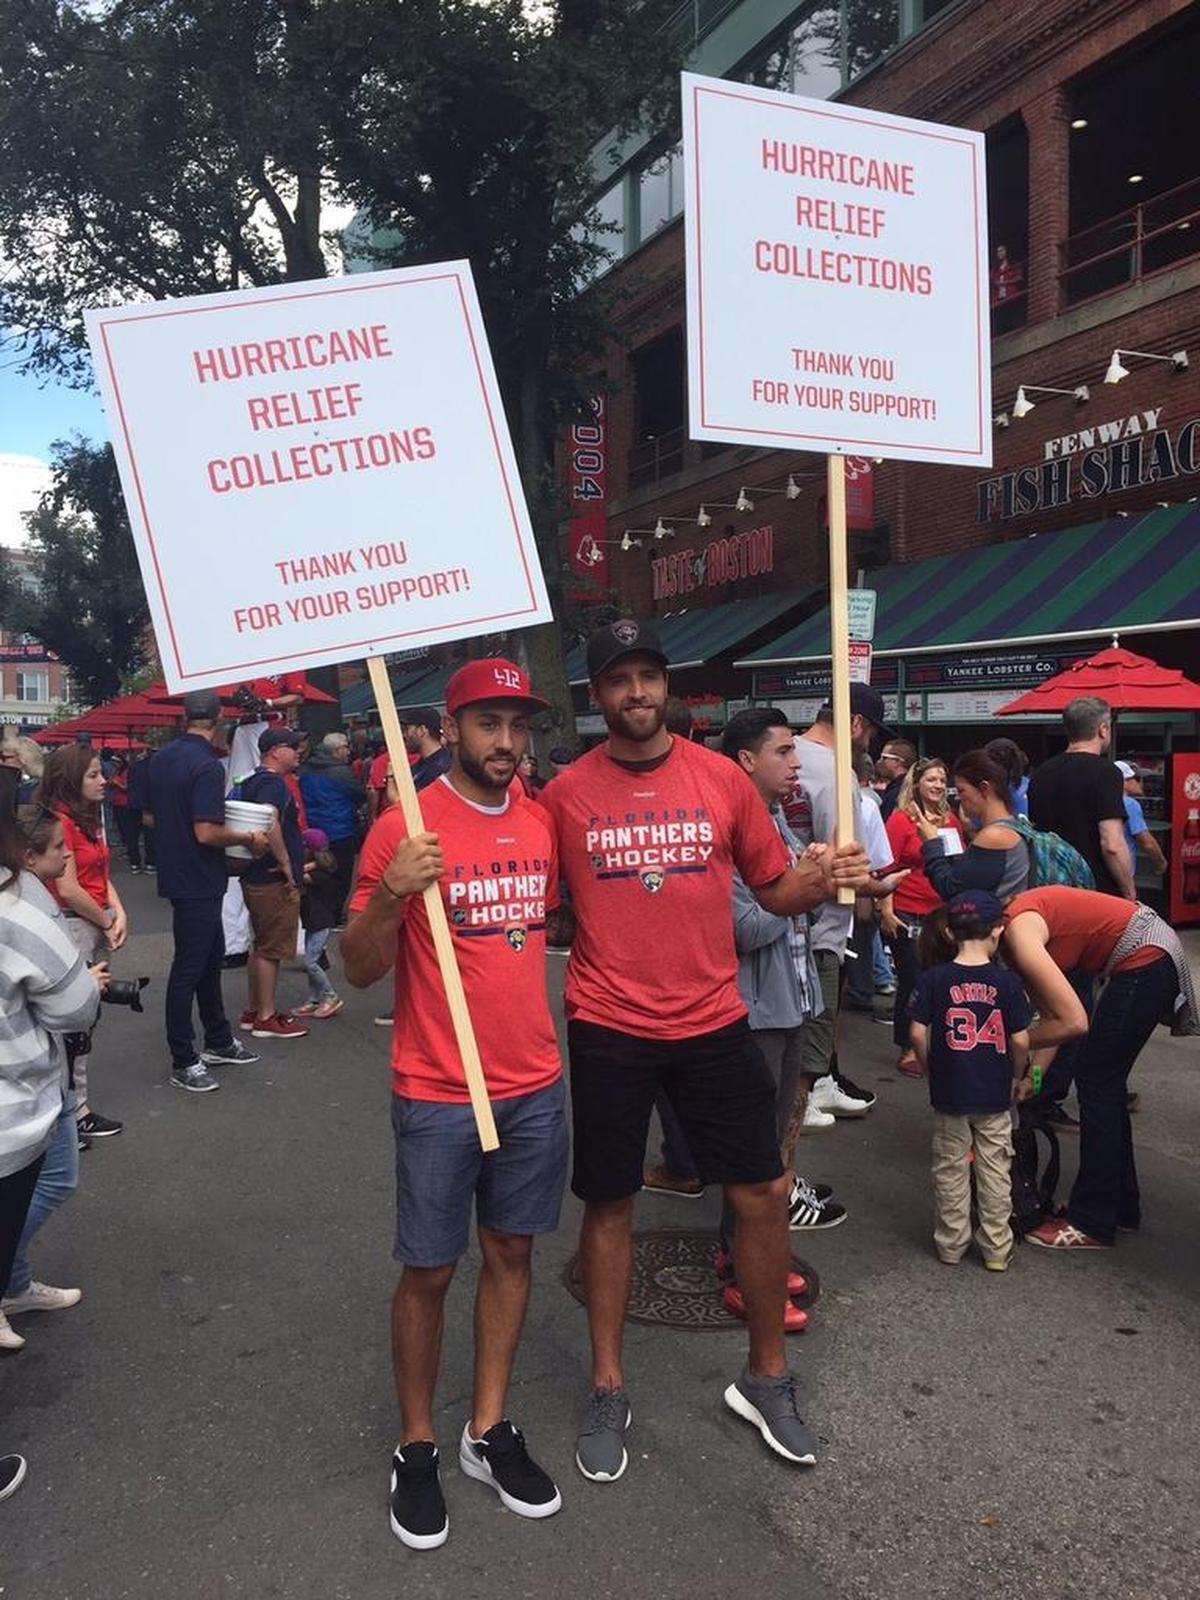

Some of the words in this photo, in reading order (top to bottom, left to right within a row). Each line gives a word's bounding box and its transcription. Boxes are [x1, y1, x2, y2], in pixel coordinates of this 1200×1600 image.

[761, 139, 915, 195] HURRICANE
[796, 196, 886, 239] RELIEF
[755, 240, 933, 295] COLLECTIONS
[193, 325, 392, 383] HURRICANE
[791, 348, 853, 376] THANK
[858, 357, 894, 382] YOU
[247, 383, 364, 431] RELIEF
[752, 379, 788, 404] FOR
[794, 385, 843, 411] YOUR
[849, 391, 936, 420] SUPPORT!
[1044, 407, 1163, 460] FENWAY
[207, 427, 437, 494] COLLECTIONS
[976, 457, 1073, 523] FISH
[275, 549, 357, 586] THANK
[362, 541, 408, 569] YOU
[651, 548, 696, 600] TASTE
[707, 525, 774, 587] BOSTON
[233, 604, 283, 633] FOR
[285, 591, 352, 624] YOUR
[356, 568, 471, 613] SUPPORT!
[493, 667, 521, 690] 412
[947, 666, 984, 677] YANKEE
[987, 664, 1033, 675] LOBSTER
[585, 822, 713, 853] PANTHERS
[605, 846, 713, 868] HOCKEY
[950, 982, 998, 1005] ORTIZ
[945, 1008, 1007, 1054] 34
